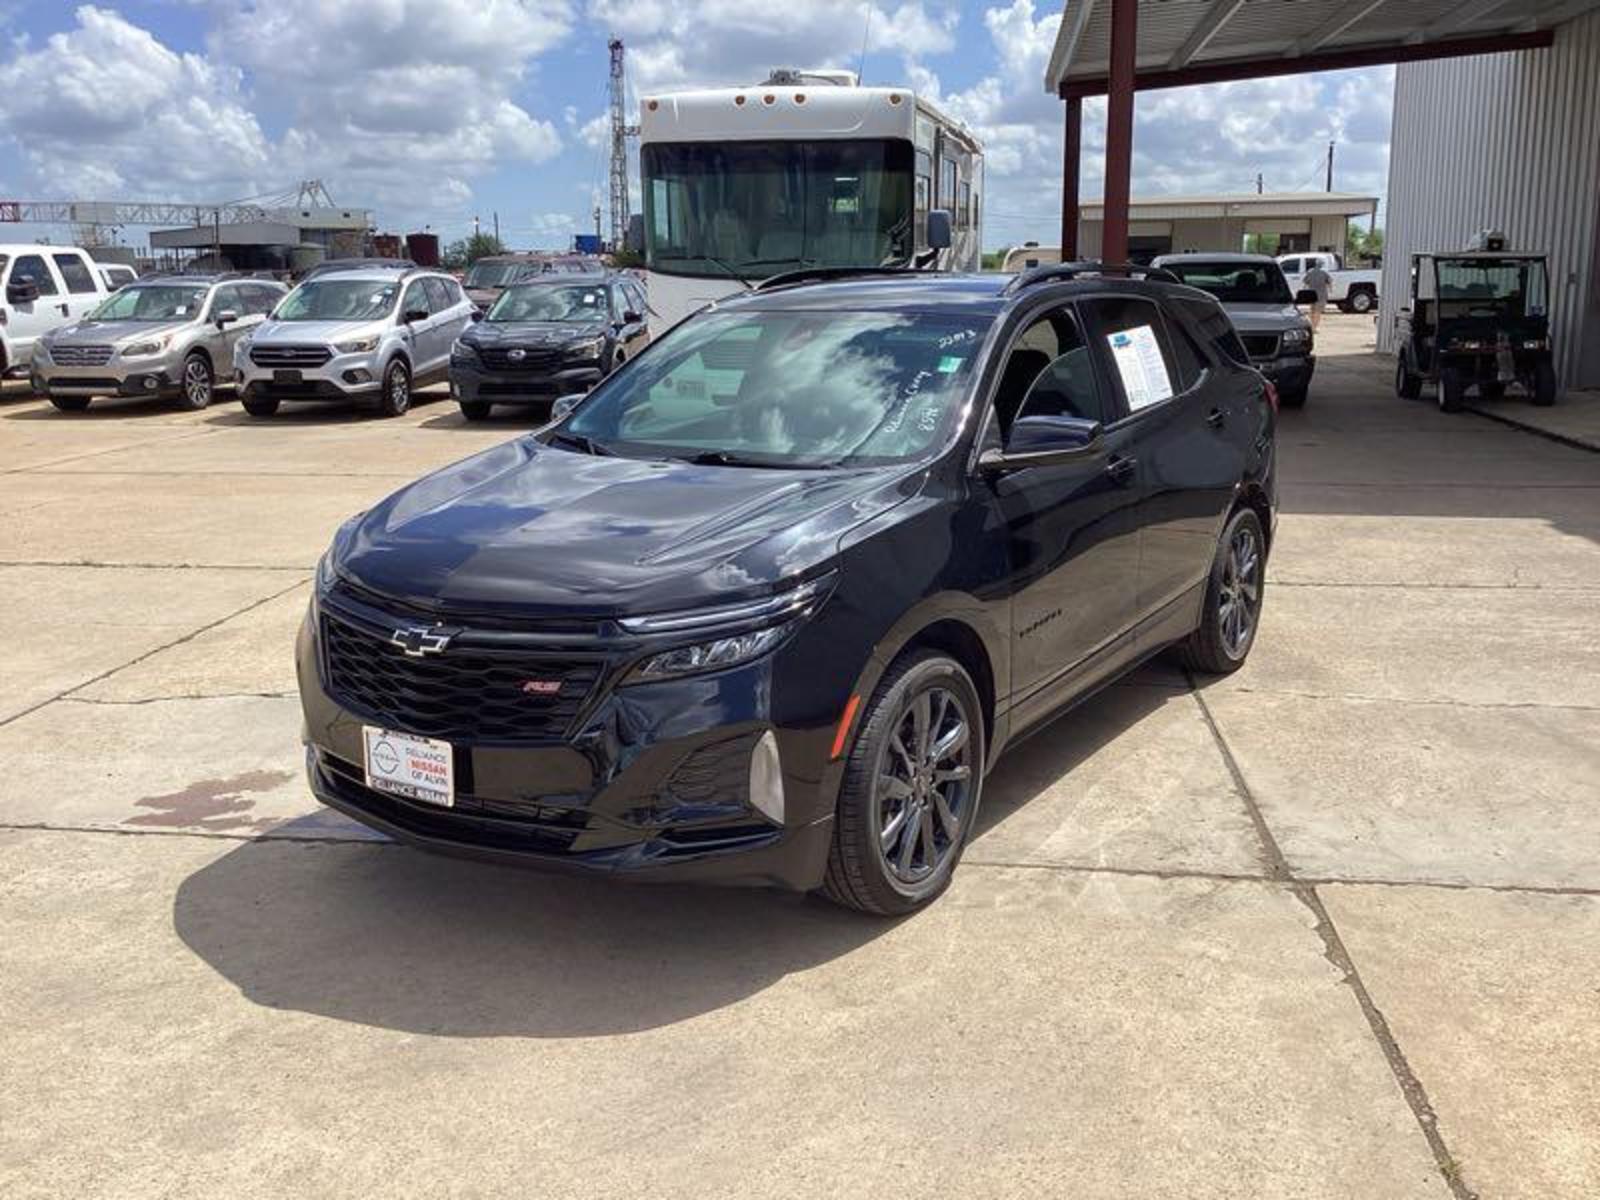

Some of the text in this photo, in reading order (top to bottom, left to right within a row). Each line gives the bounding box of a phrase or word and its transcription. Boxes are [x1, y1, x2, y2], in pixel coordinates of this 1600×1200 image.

[411, 760, 447, 776] NISSAN
[411, 771, 448, 785] OF ALVIN
